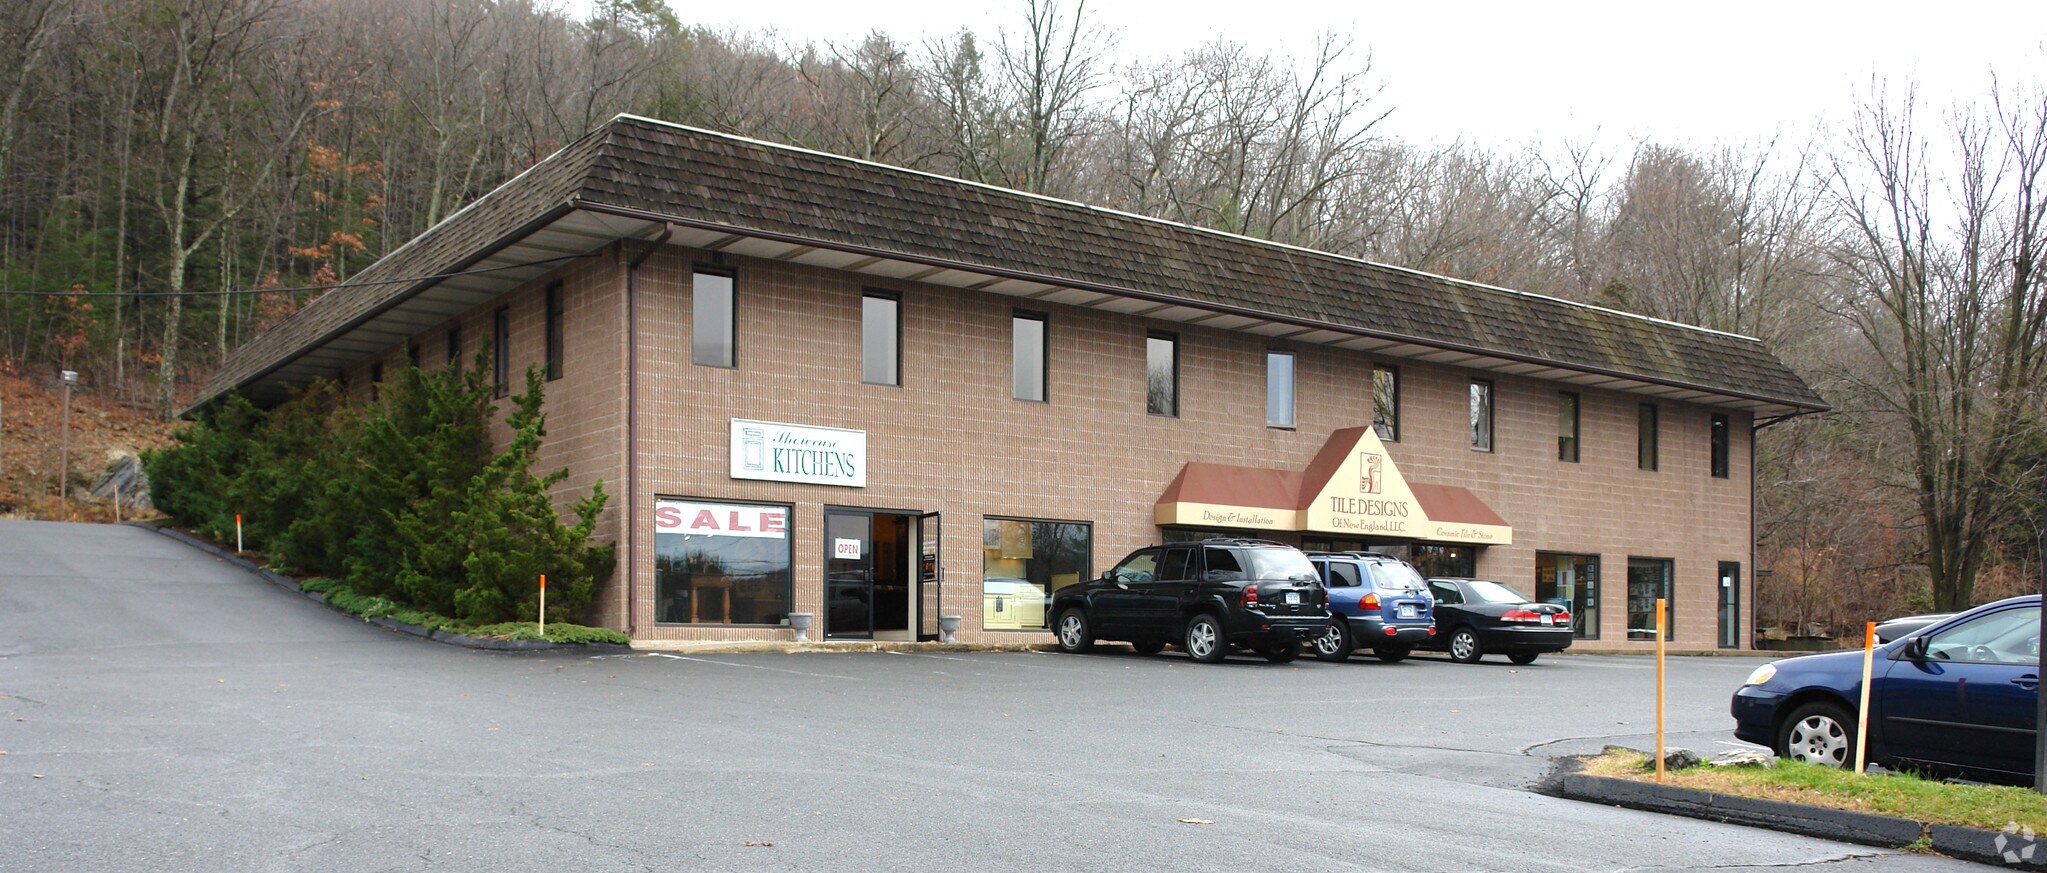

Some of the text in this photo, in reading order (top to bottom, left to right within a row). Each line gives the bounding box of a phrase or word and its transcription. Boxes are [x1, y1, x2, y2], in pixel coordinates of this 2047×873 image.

[772, 431, 838, 448] Showcase
[773, 447, 855, 477] KITCHENS
[1331, 496, 1409, 517] TILE DESIGNS
[656, 506, 785, 532] SALE
[1203, 510, 1273, 525] Design & Installation
[1332, 517, 1342, 528] Of
[1343, 518, 1359, 529] New
[838, 543, 859, 555] OPEN
